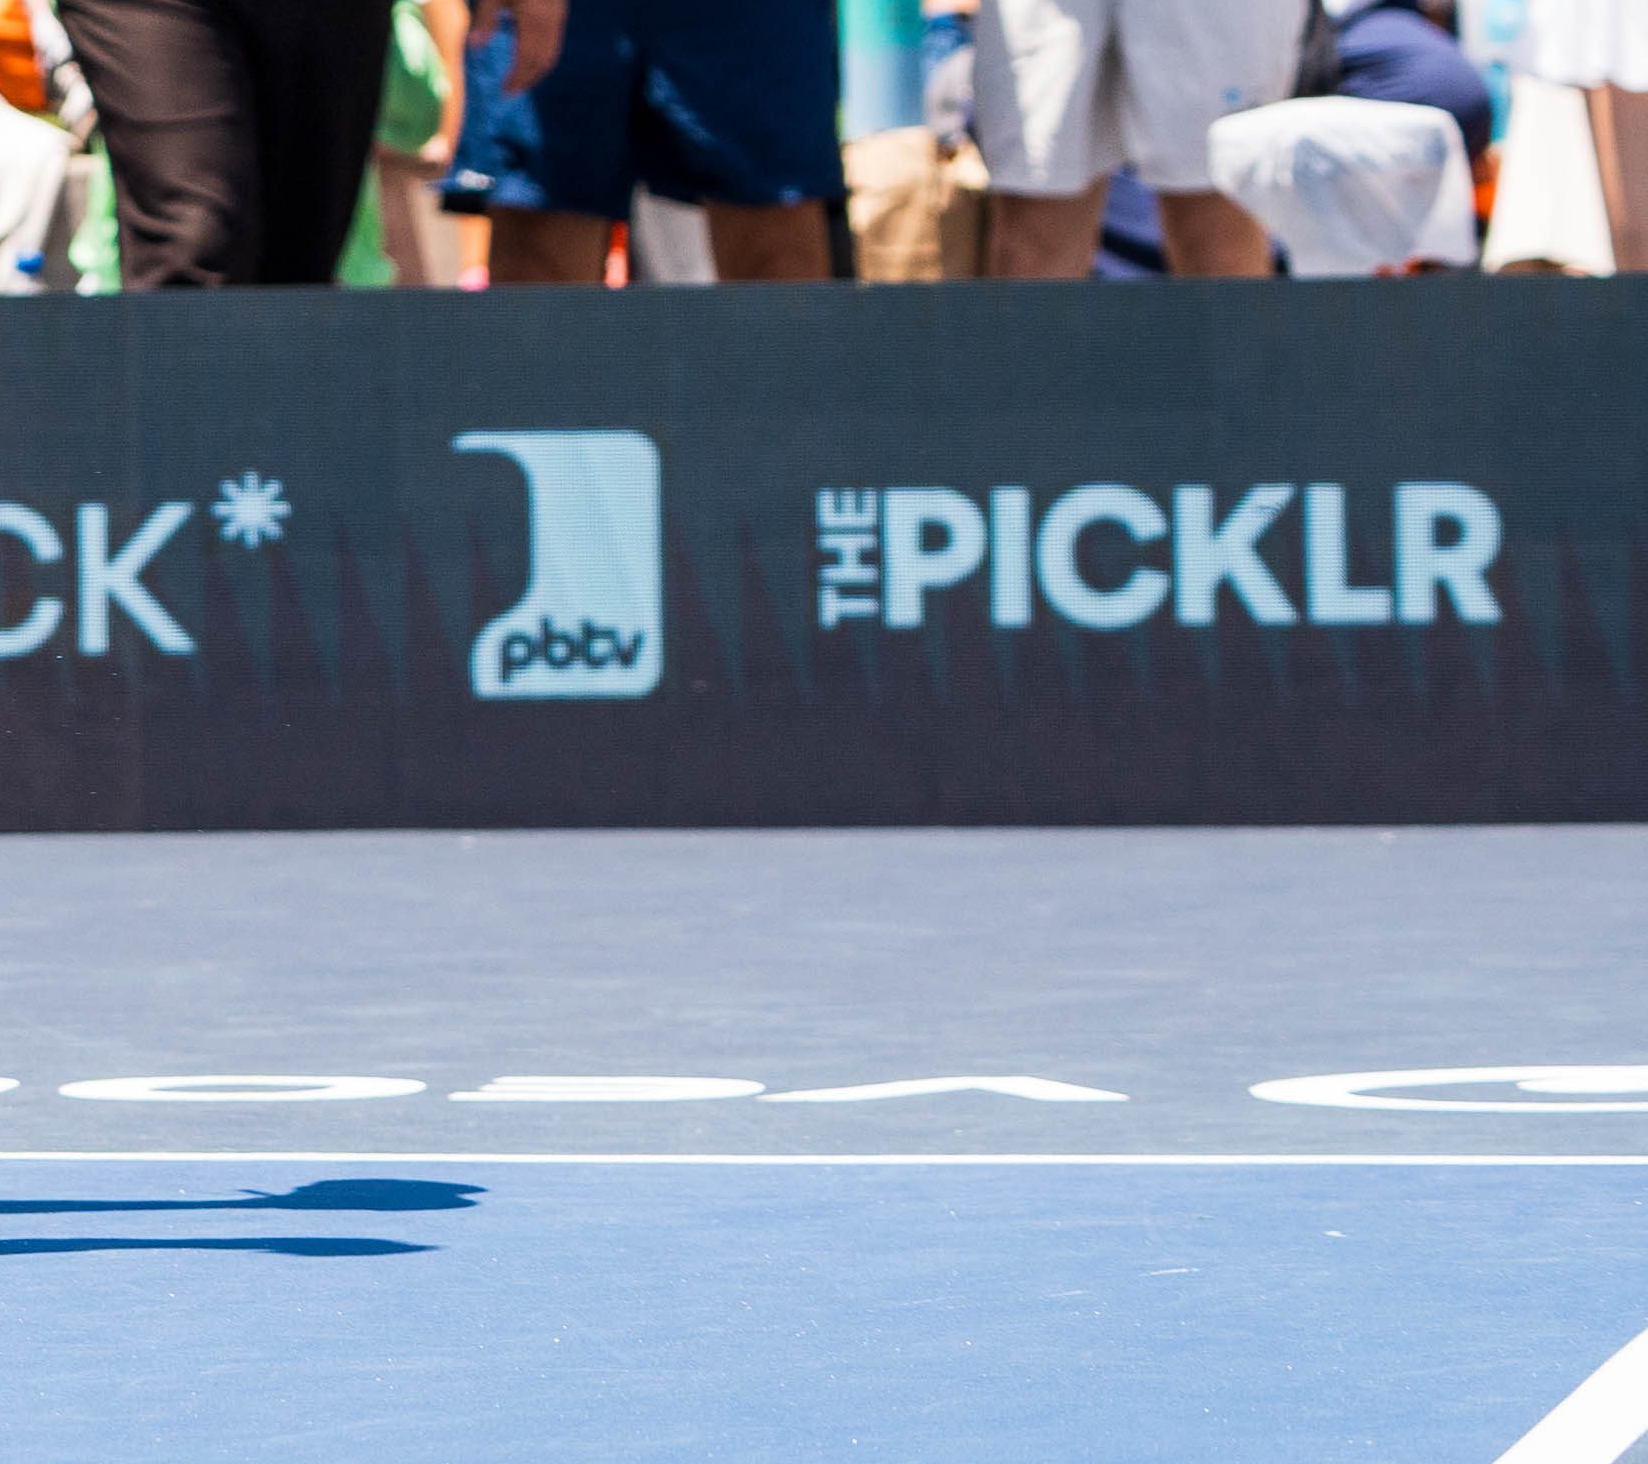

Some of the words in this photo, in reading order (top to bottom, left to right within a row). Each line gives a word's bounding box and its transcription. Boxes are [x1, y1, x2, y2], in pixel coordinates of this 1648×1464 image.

[816, 486, 880, 630] THE
[882, 480, 1503, 631] PICKLR
[498, 616, 645, 685] pbtv
